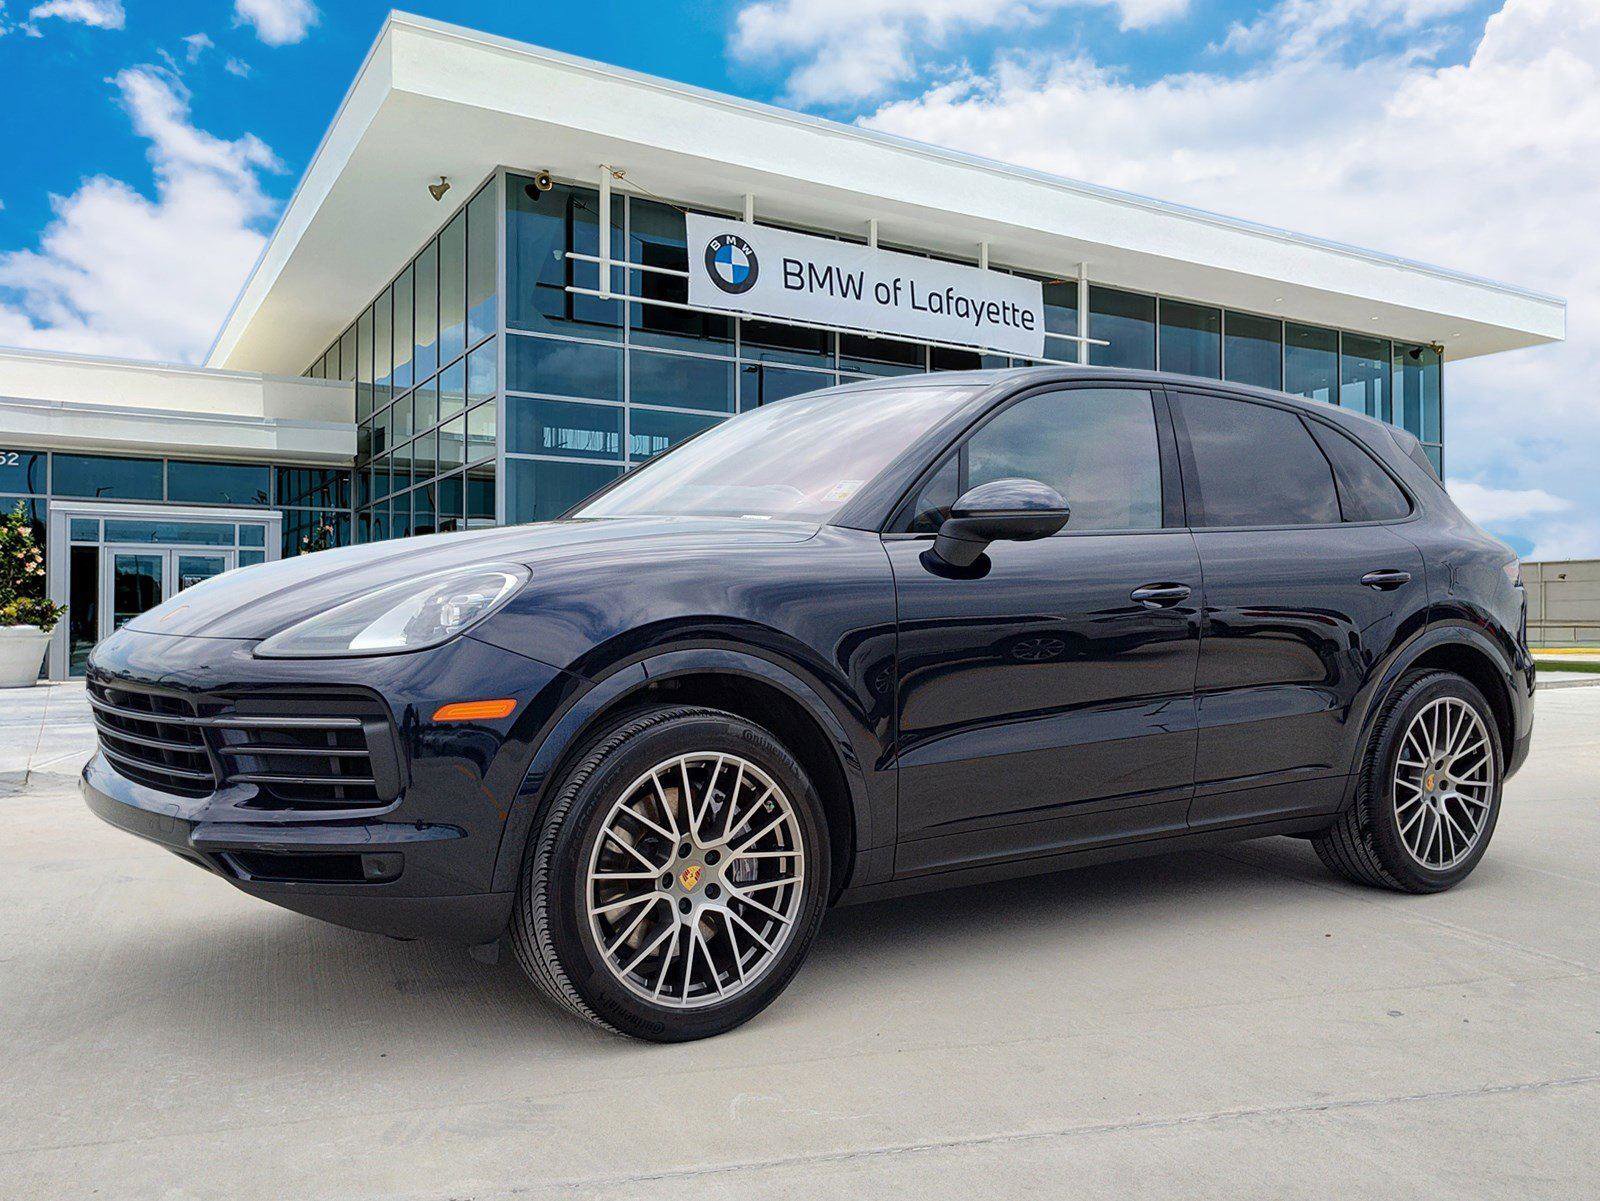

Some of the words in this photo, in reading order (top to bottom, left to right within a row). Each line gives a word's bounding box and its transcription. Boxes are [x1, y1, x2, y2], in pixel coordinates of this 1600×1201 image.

[709, 236, 753, 256] BMW
[783, 258, 864, 300] BMW
[875, 278, 902, 306] of
[910, 281, 1034, 331] Lafayette
